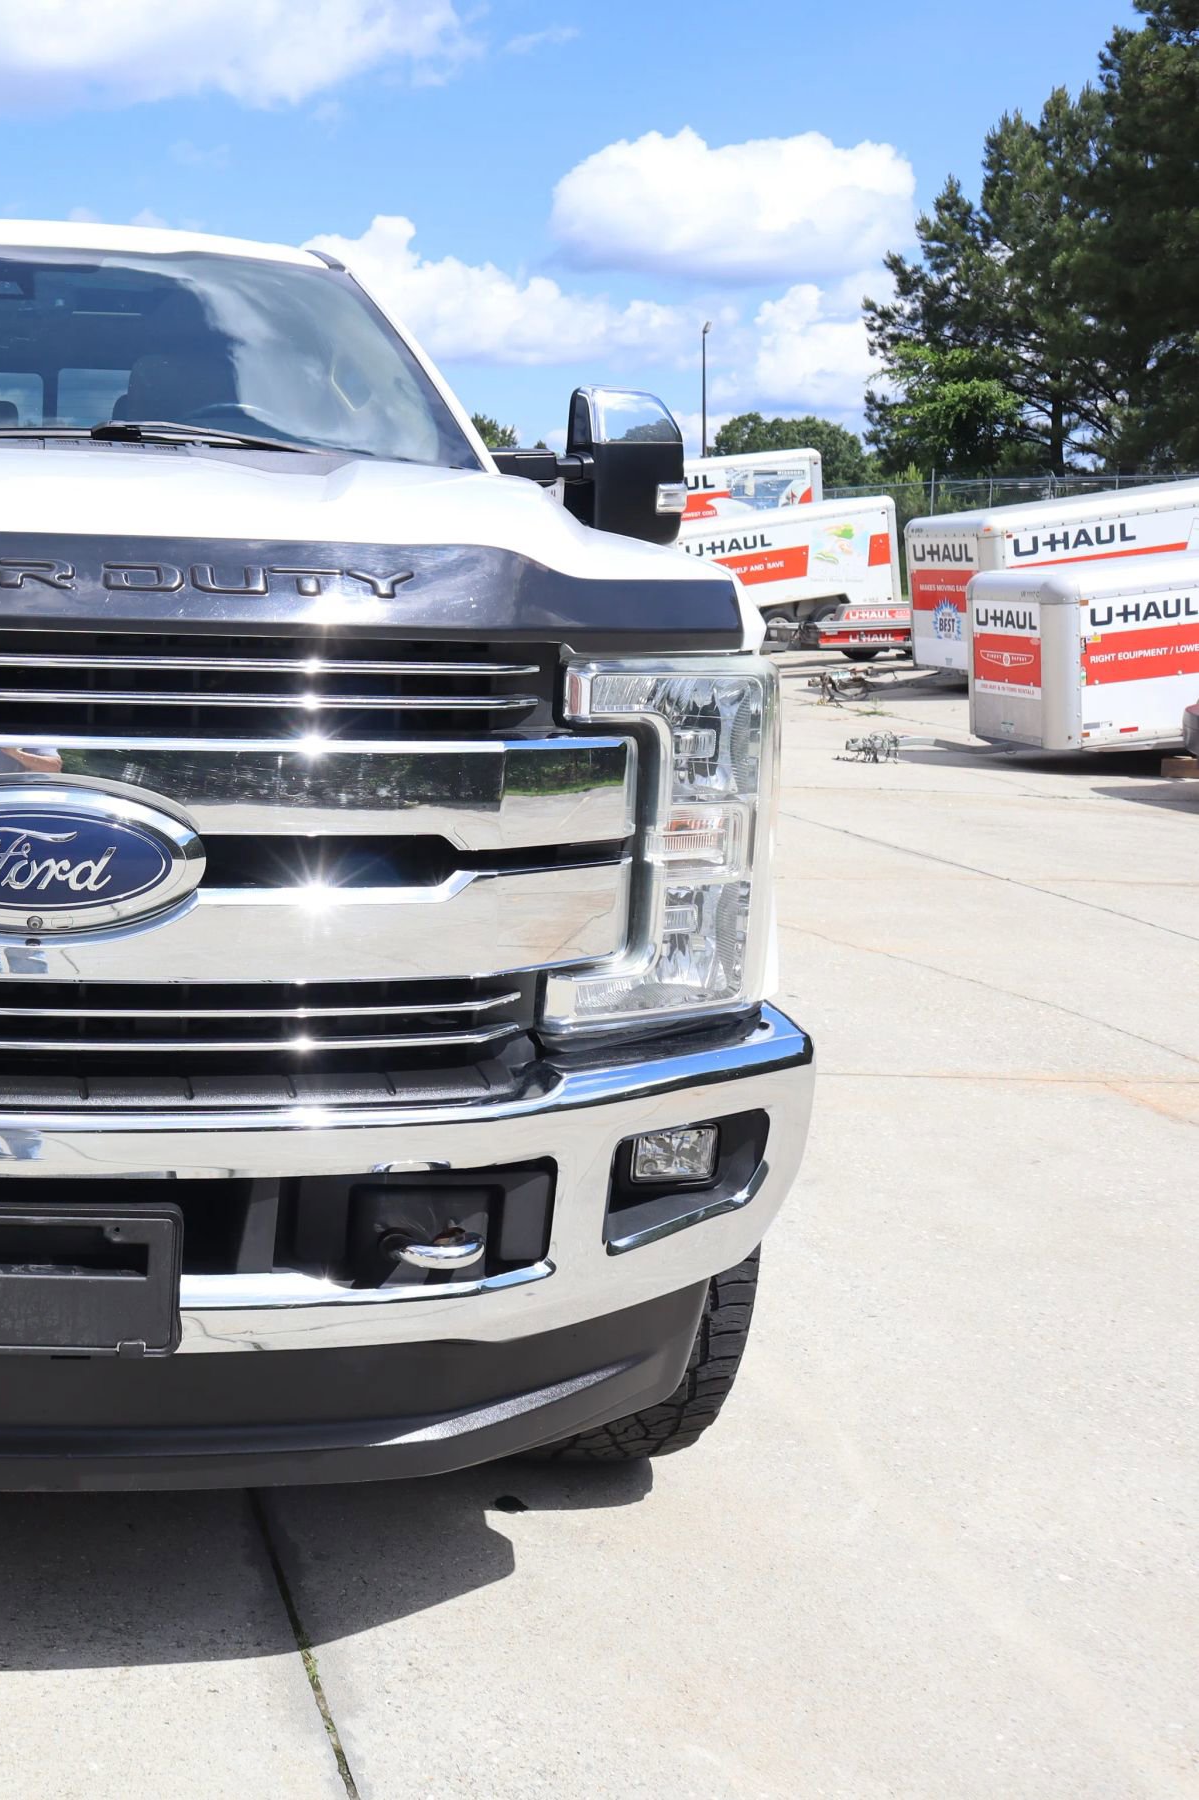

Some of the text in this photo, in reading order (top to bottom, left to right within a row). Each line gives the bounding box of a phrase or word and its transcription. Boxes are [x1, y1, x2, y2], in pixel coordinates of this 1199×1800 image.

[1013, 523, 1136, 558] U-HAUL
[912, 543, 973, 562] U-HAUL
[102, 560, 415, 599] DUTY
[849, 610, 890, 619] U-HAUL
[975, 608, 1037, 631] U-HAUL
[1090, 597, 1198, 627] U-HAUL
[939, 618, 955, 632] BEST
[1089, 653, 1116, 664] RIGHT
[1118, 647, 1168, 660] EQUIPMENT
